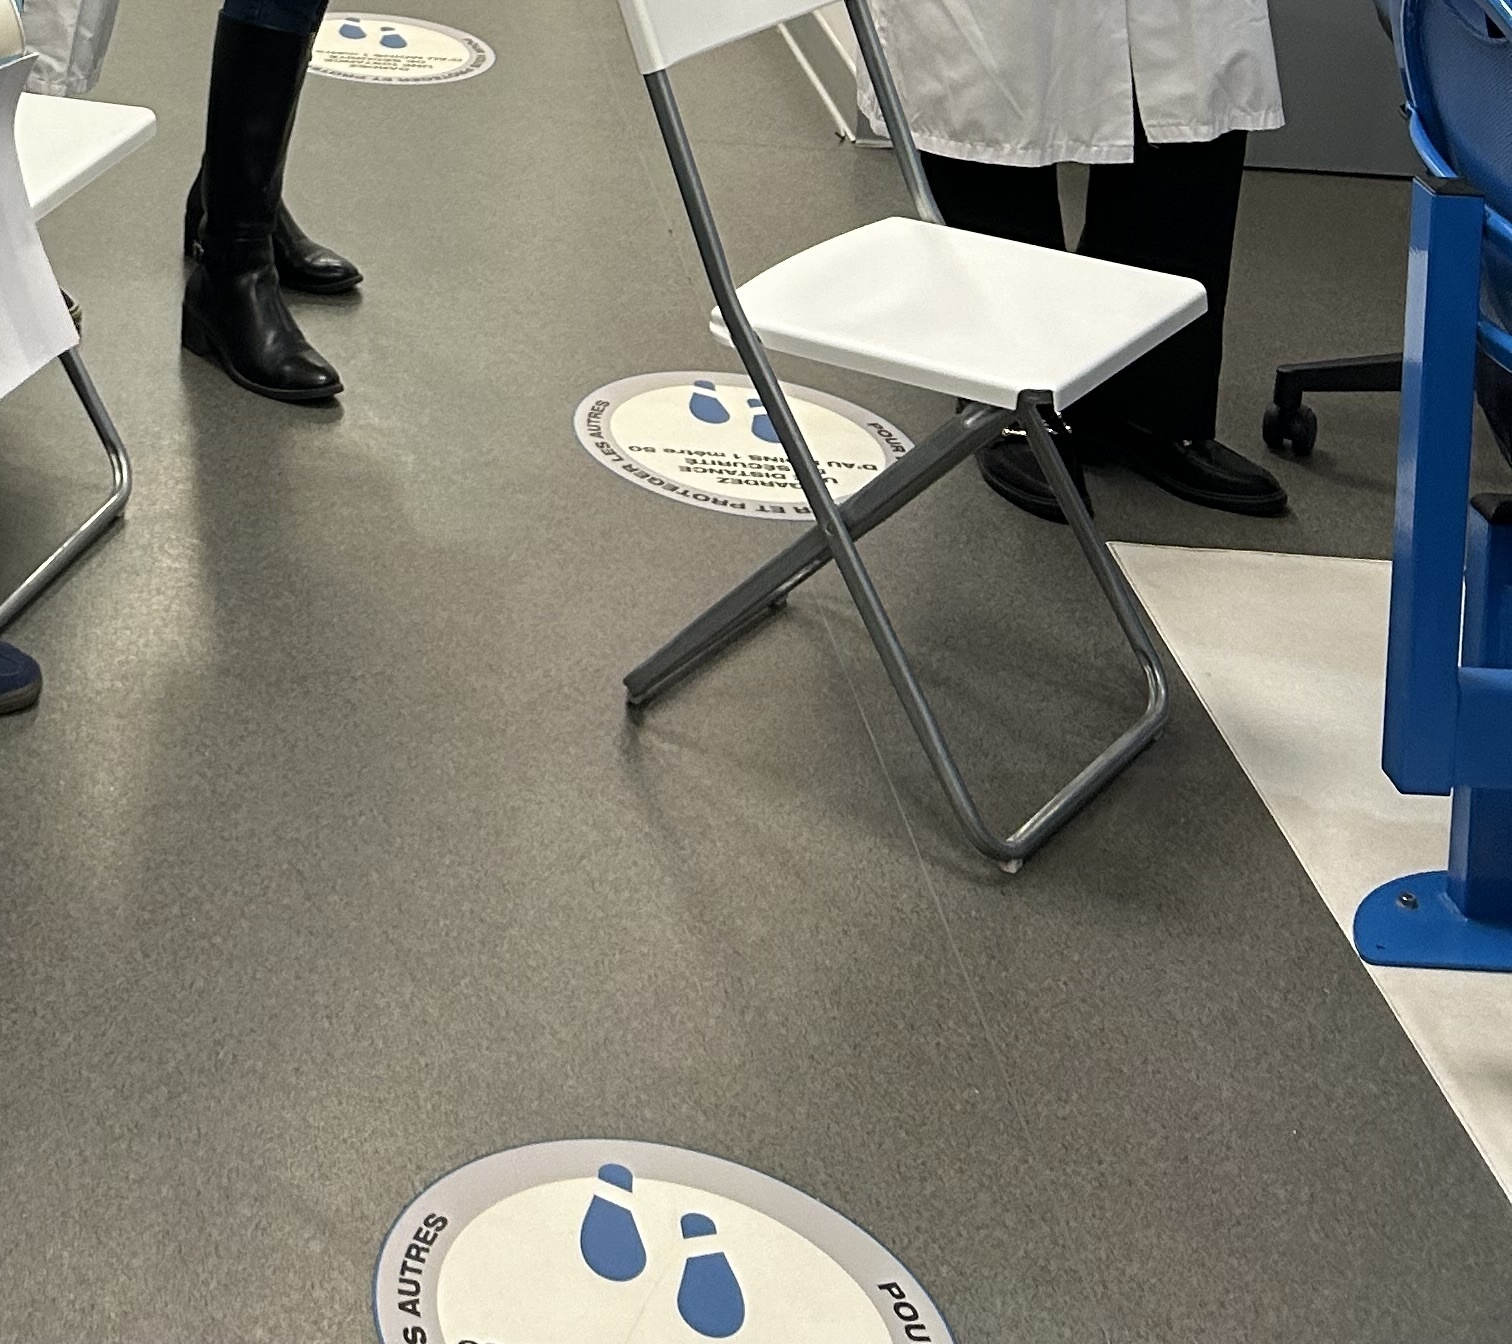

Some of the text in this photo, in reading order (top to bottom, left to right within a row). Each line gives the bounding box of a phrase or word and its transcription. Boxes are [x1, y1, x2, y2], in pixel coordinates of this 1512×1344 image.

[586, 399, 610, 439] AUTRES
[595, 441, 625, 462] LES
[397, 1213, 449, 1318] AUTRES
